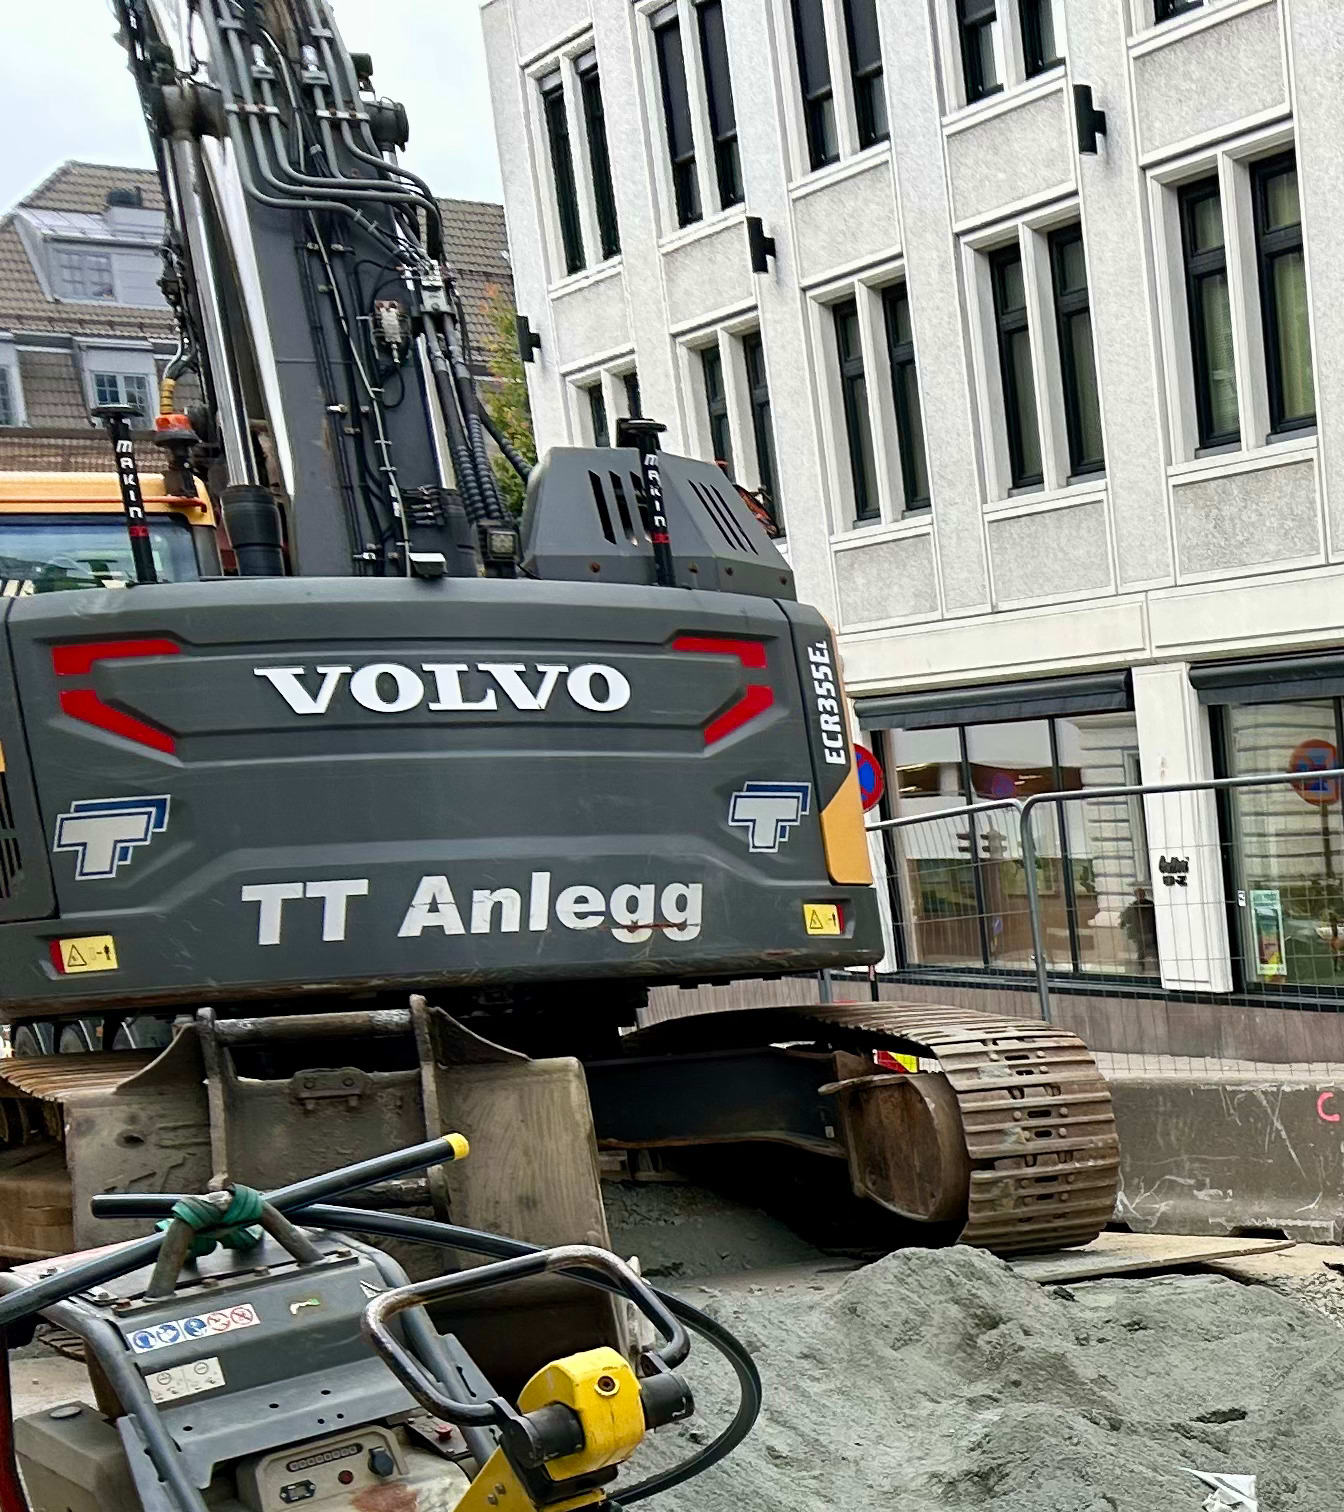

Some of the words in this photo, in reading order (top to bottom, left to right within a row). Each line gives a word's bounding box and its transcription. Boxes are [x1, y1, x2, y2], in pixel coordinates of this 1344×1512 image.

[253, 662, 632, 715] VOLVO
[242, 878, 369, 946] TT
[397, 871, 703, 944] Anlegg
